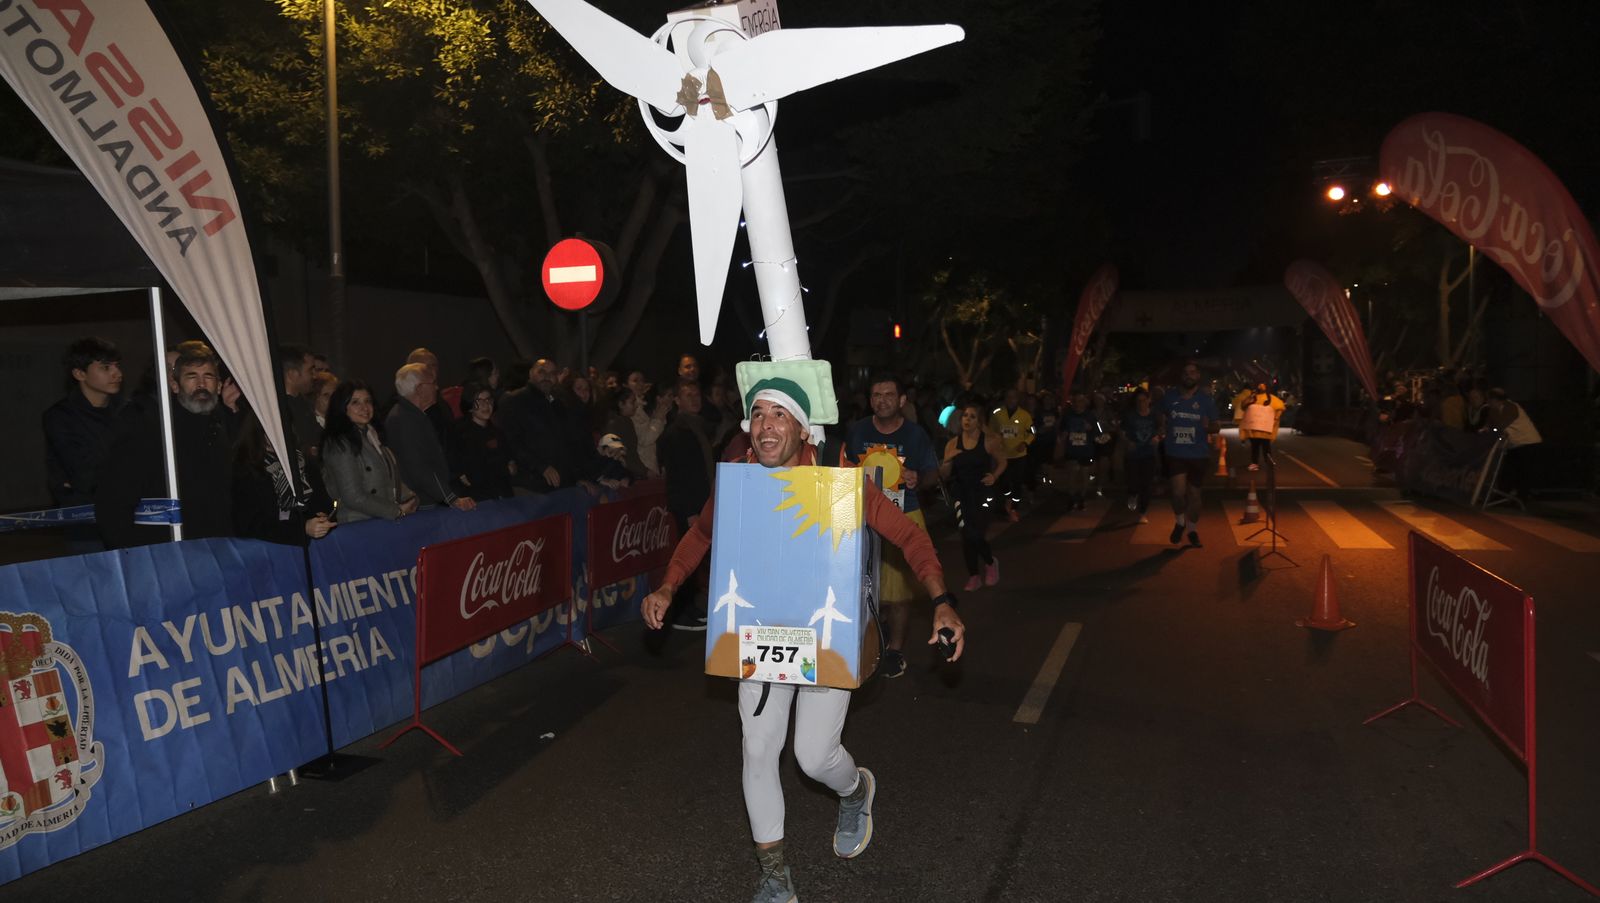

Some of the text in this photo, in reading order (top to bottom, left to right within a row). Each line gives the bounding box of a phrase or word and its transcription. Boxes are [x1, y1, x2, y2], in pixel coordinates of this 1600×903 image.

[612, 504, 672, 564] Coca-Cola
[459, 536, 546, 620] Coca-Cola
[757, 646, 799, 663] 757
[1426, 565, 1492, 685] Coca-Cola
[133, 622, 396, 742] DE ALMERÍA
[20, 820, 34, 831] DE
